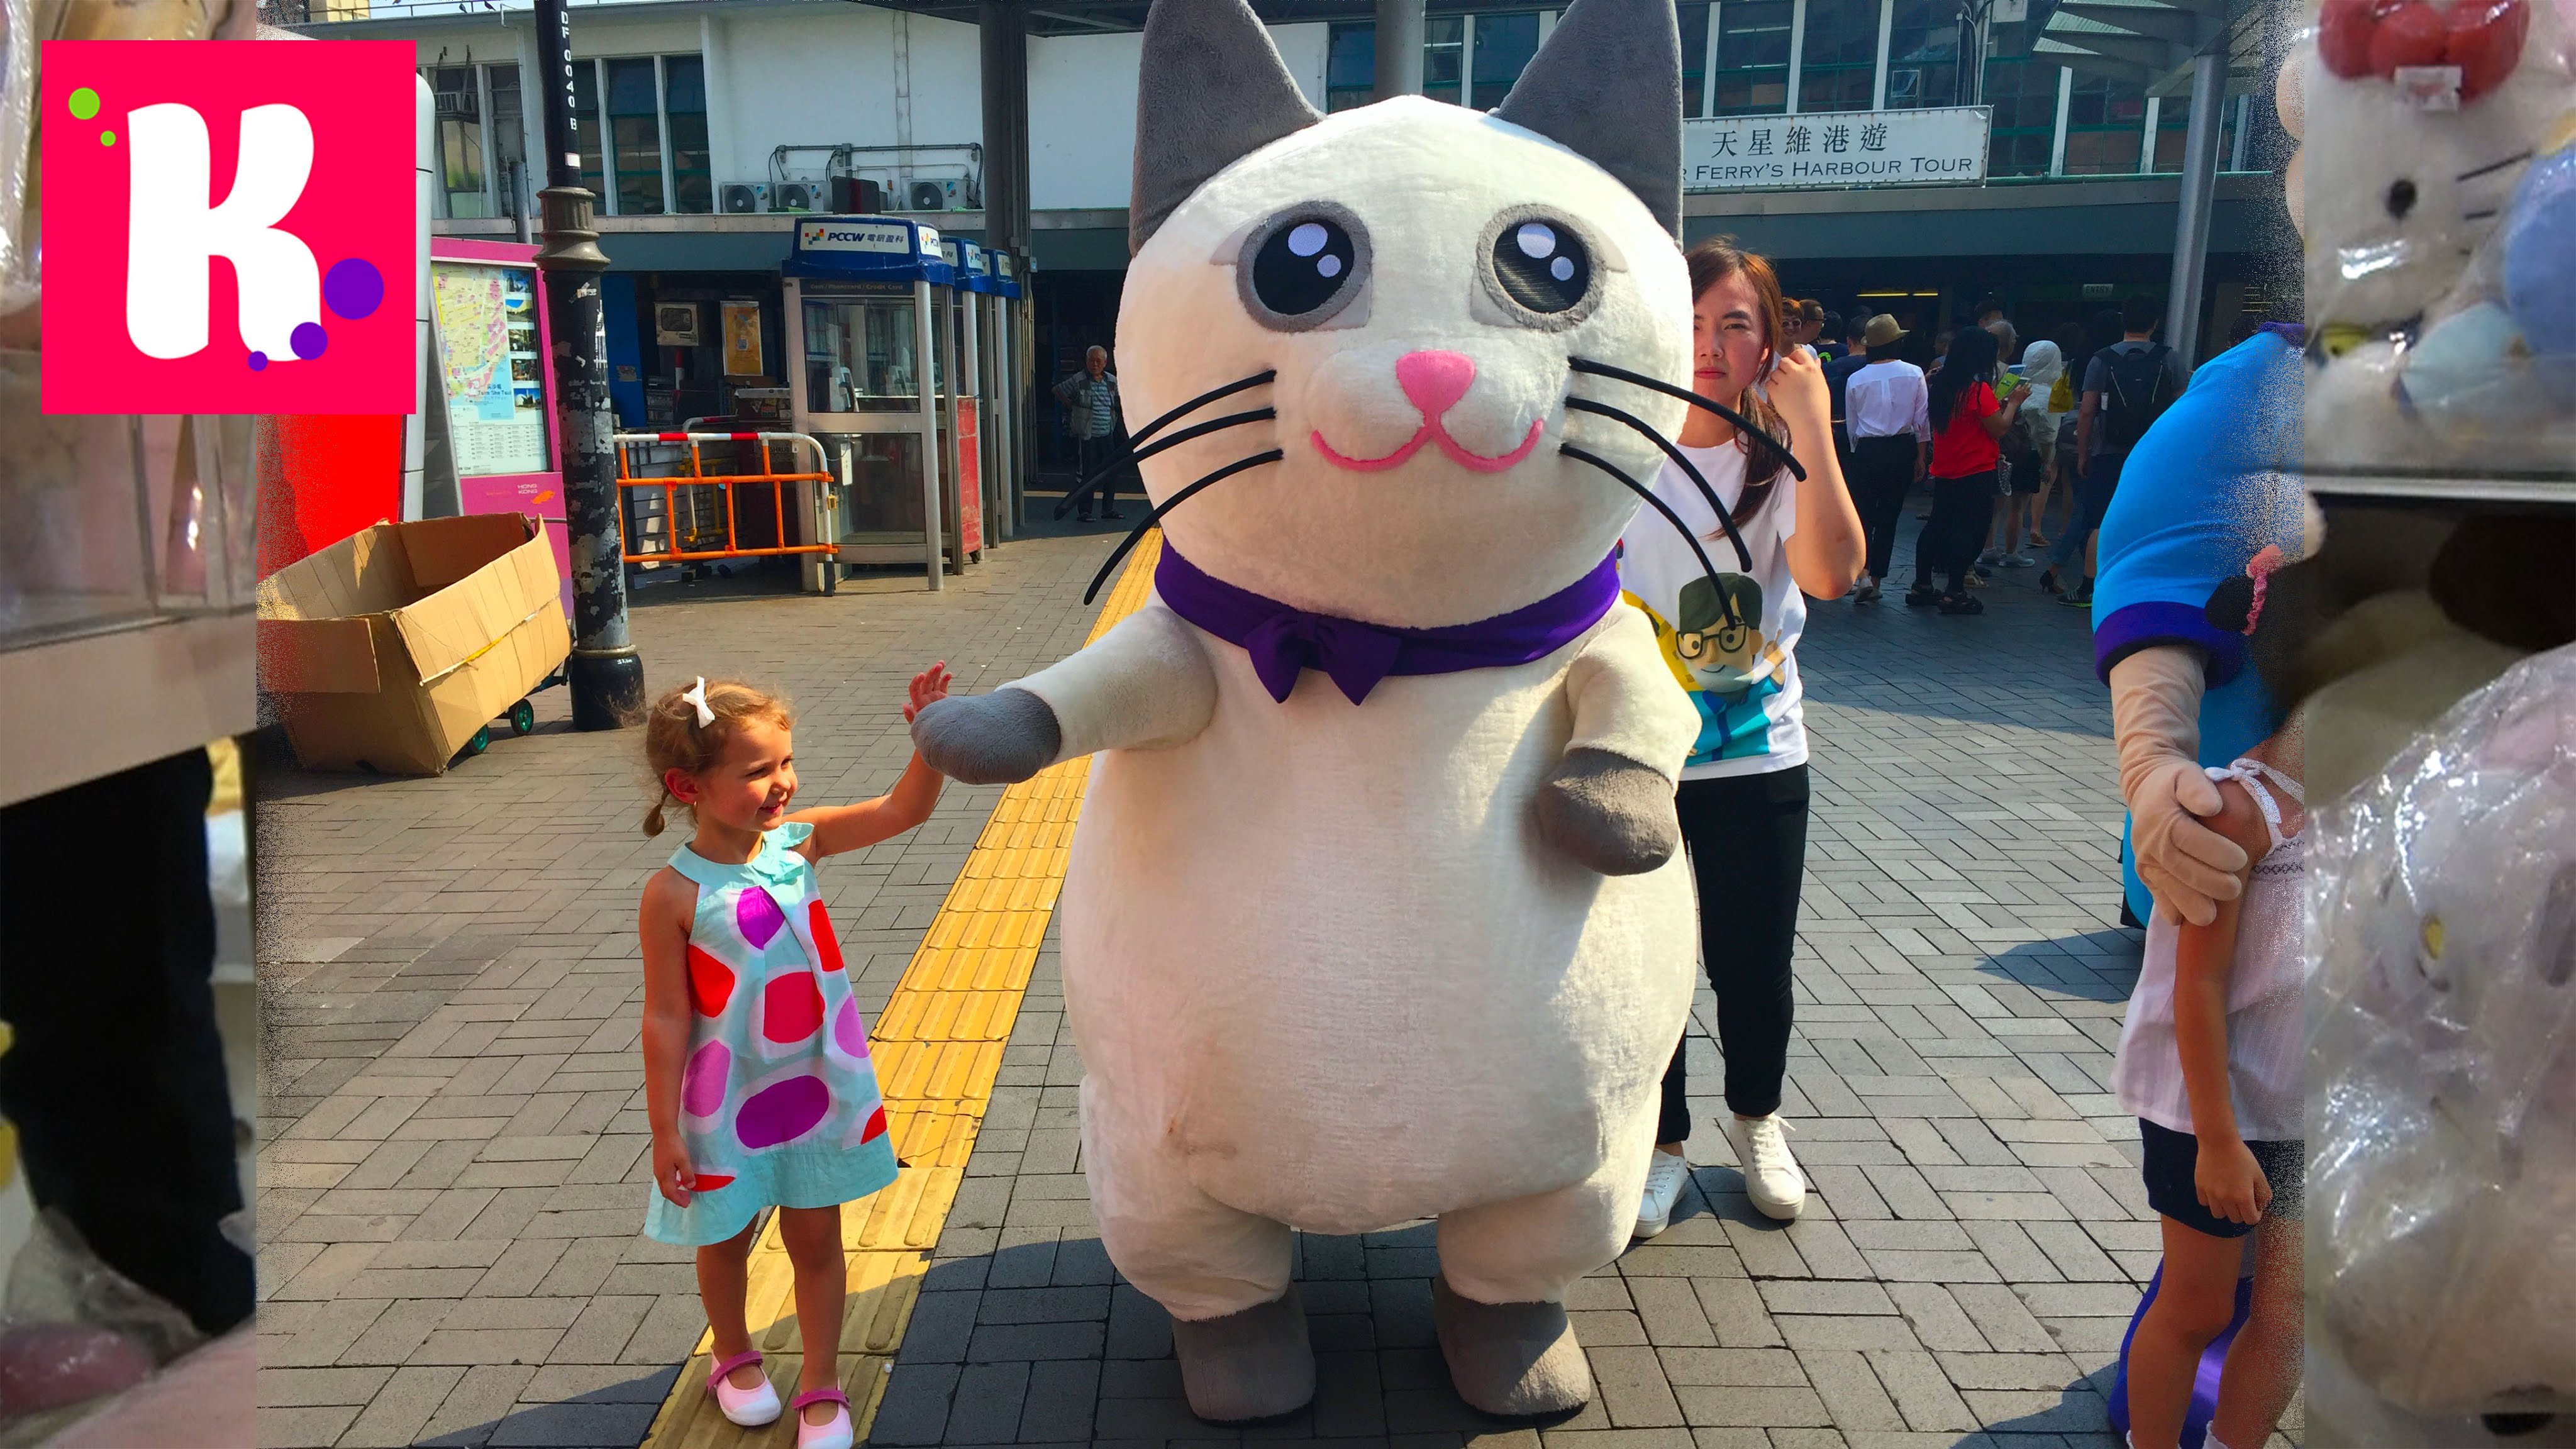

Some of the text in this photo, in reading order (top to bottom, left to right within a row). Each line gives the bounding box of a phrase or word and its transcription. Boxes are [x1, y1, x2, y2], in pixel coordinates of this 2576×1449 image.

[560, 10, 577, 131] DF 0040 B
[1711, 123, 1888, 159] 天星維港遊
[1696, 164, 1784, 181] FERRY'S
[1792, 159, 1902, 177] HARBOUR
[1911, 156, 1973, 174] TOUR
[827, 232, 904, 243] PCCW 電訊盈科
